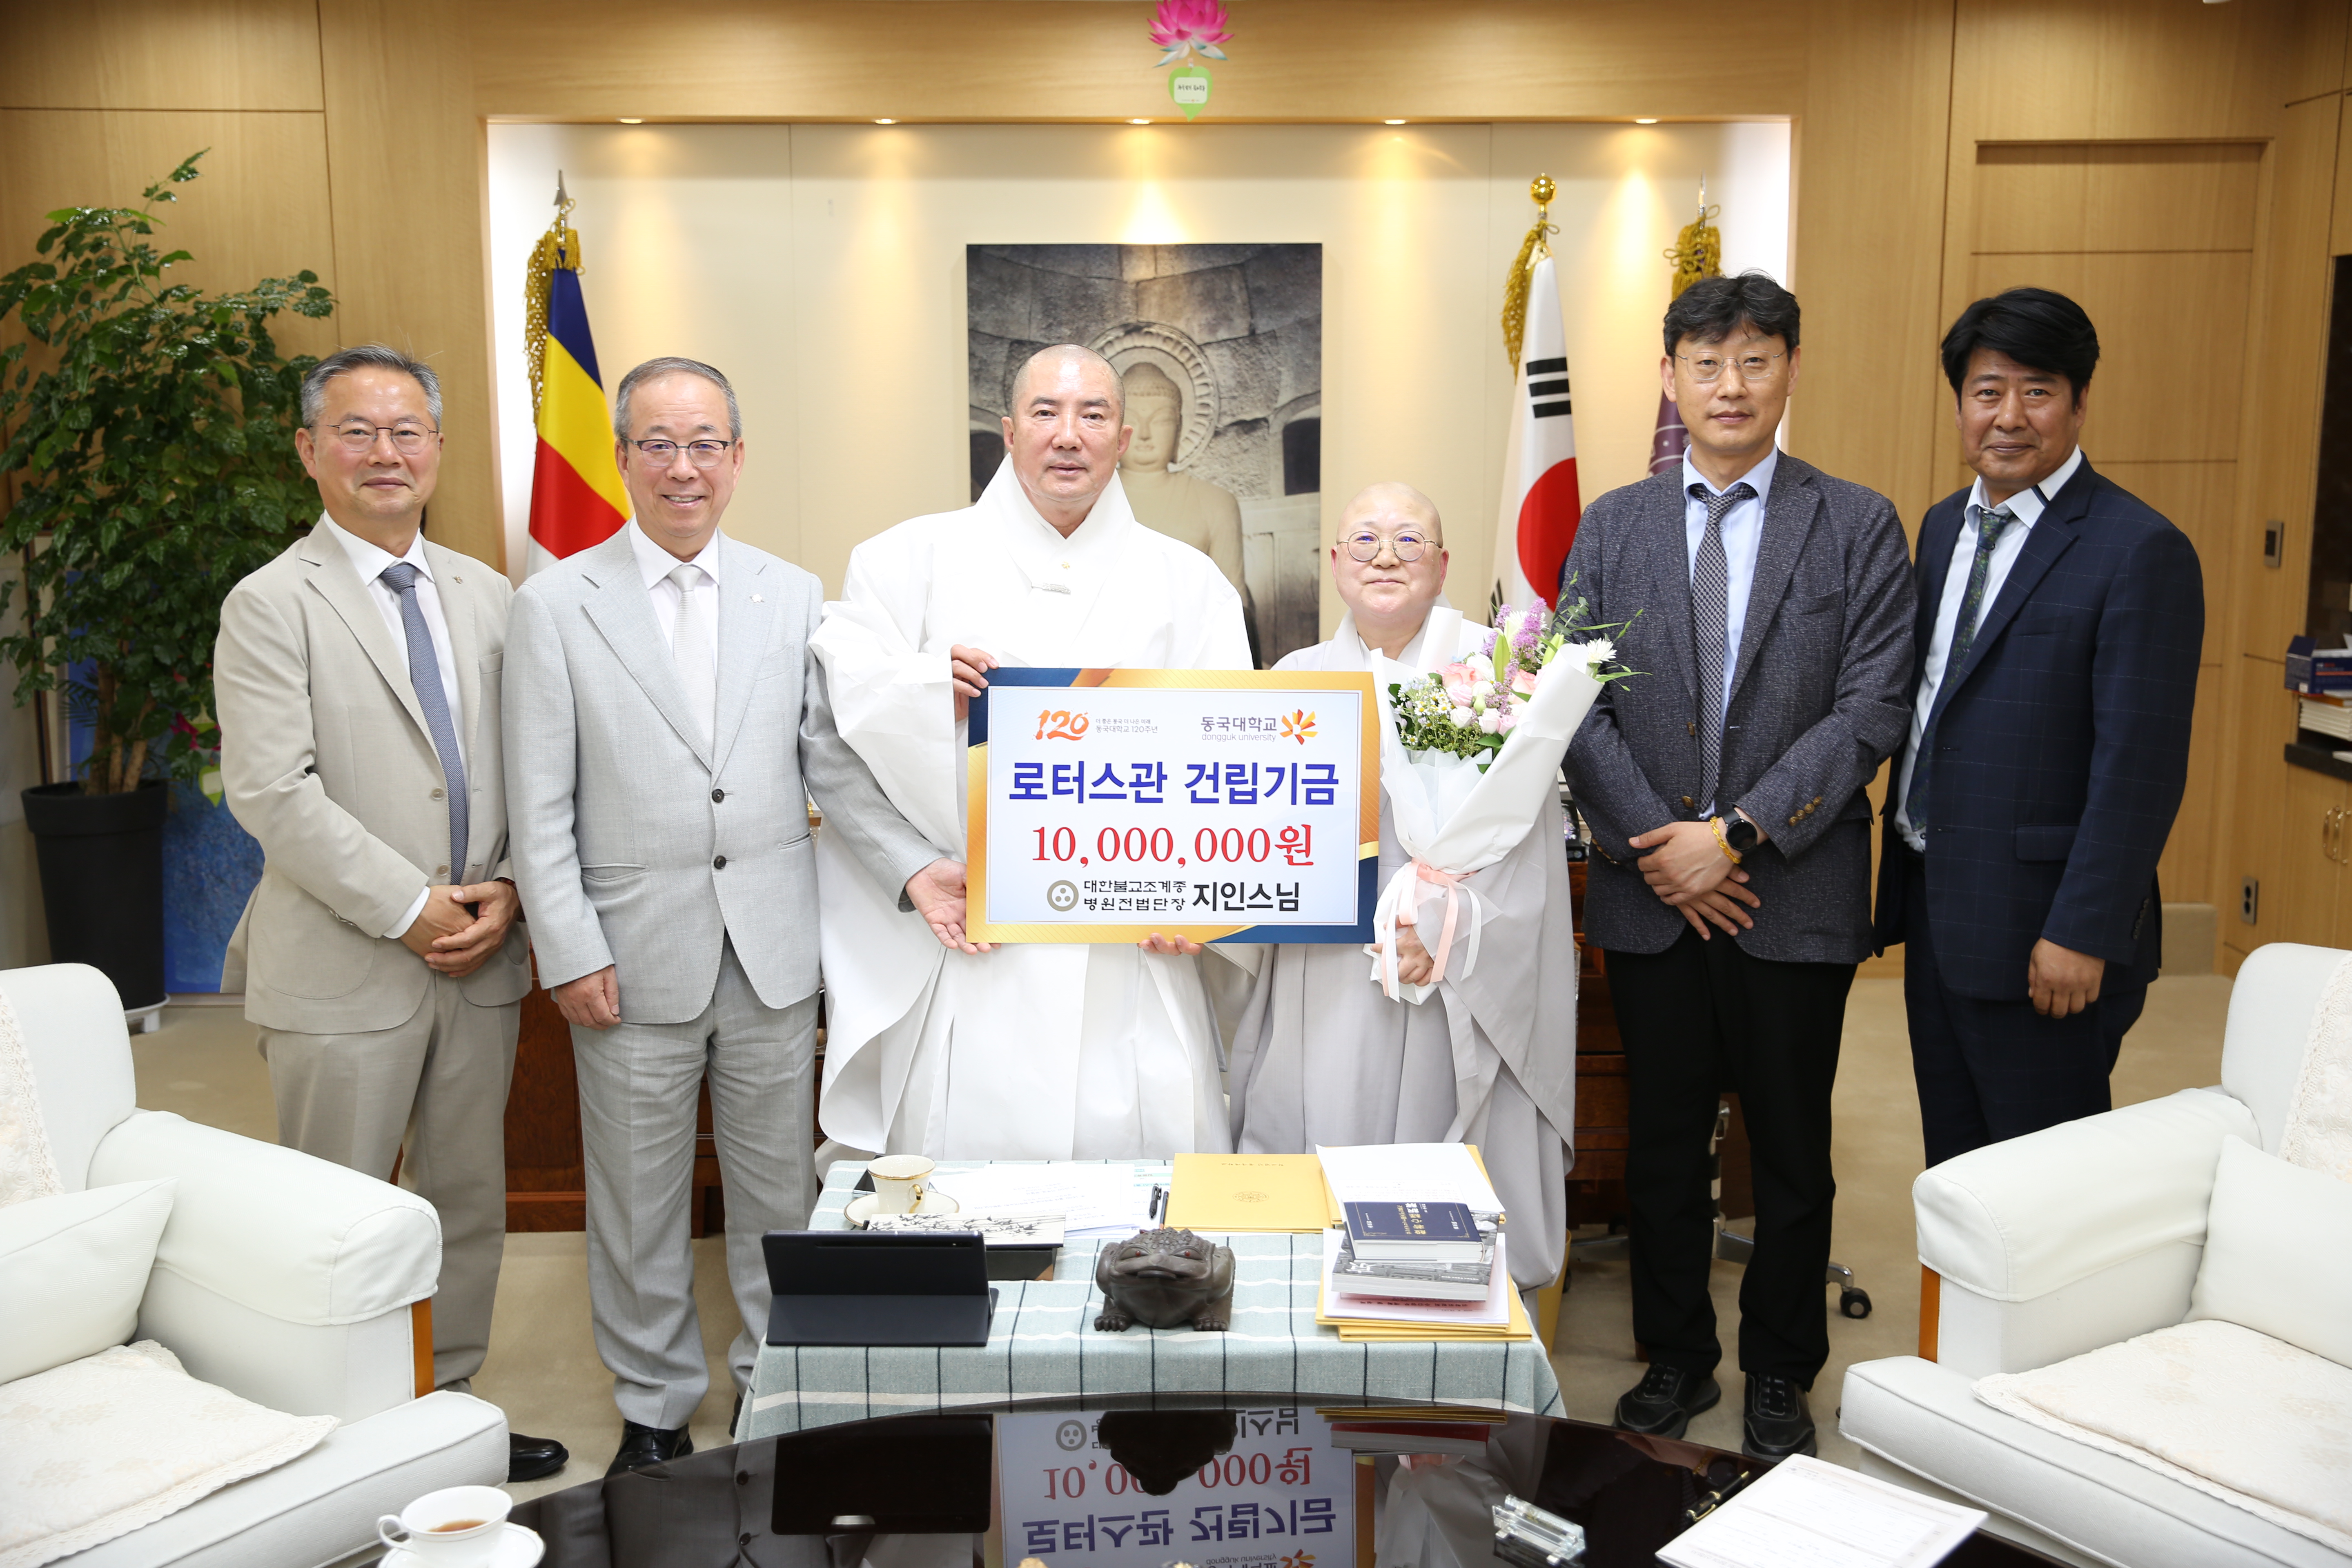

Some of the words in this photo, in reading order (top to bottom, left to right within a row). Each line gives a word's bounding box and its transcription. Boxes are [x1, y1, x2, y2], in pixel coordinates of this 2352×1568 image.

[1036, 710, 1089, 741] 120
[1201, 717, 1276, 732] 동국대학교
[1202, 733, 1236, 742] dongguk
[1009, 761, 1167, 804] 로터스관
[1185, 762, 1339, 805] 건립기금
[1033, 824, 1314, 868] 10,000,000원
[1084, 880, 1186, 893] 대한불교조계종
[1192, 882, 1299, 911] 지인스님
[1084, 898, 1185, 911] 병원전법단장
